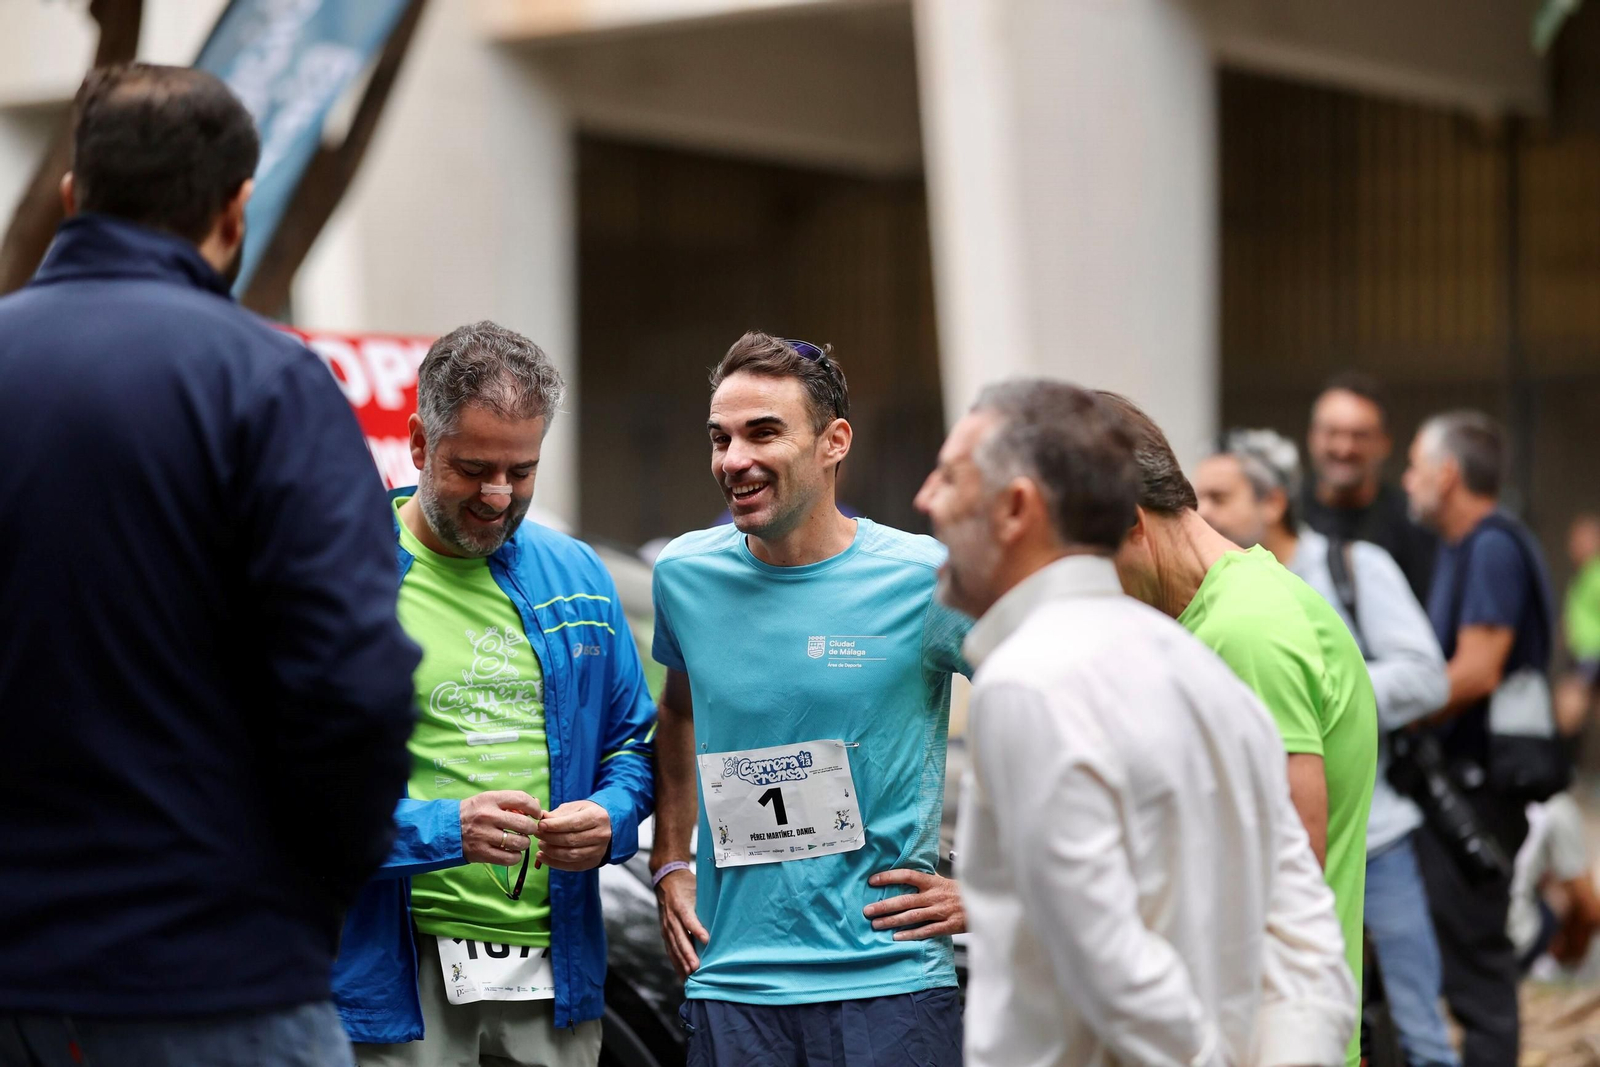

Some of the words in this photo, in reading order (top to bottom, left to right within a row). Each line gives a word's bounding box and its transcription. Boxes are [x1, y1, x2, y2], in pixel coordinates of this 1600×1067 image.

[829, 640, 856, 648] Ciudad
[839, 648, 866, 657] Málaga
[437, 683, 538, 711] Carrera
[799, 752, 810, 760] de
[740, 757, 798, 775] Carrera
[758, 787, 788, 826] 1
[750, 832, 766, 841] PÉREZ
[766, 830, 796, 840] MARTÍNEZ,
[796, 826, 816, 836] DANIEL
